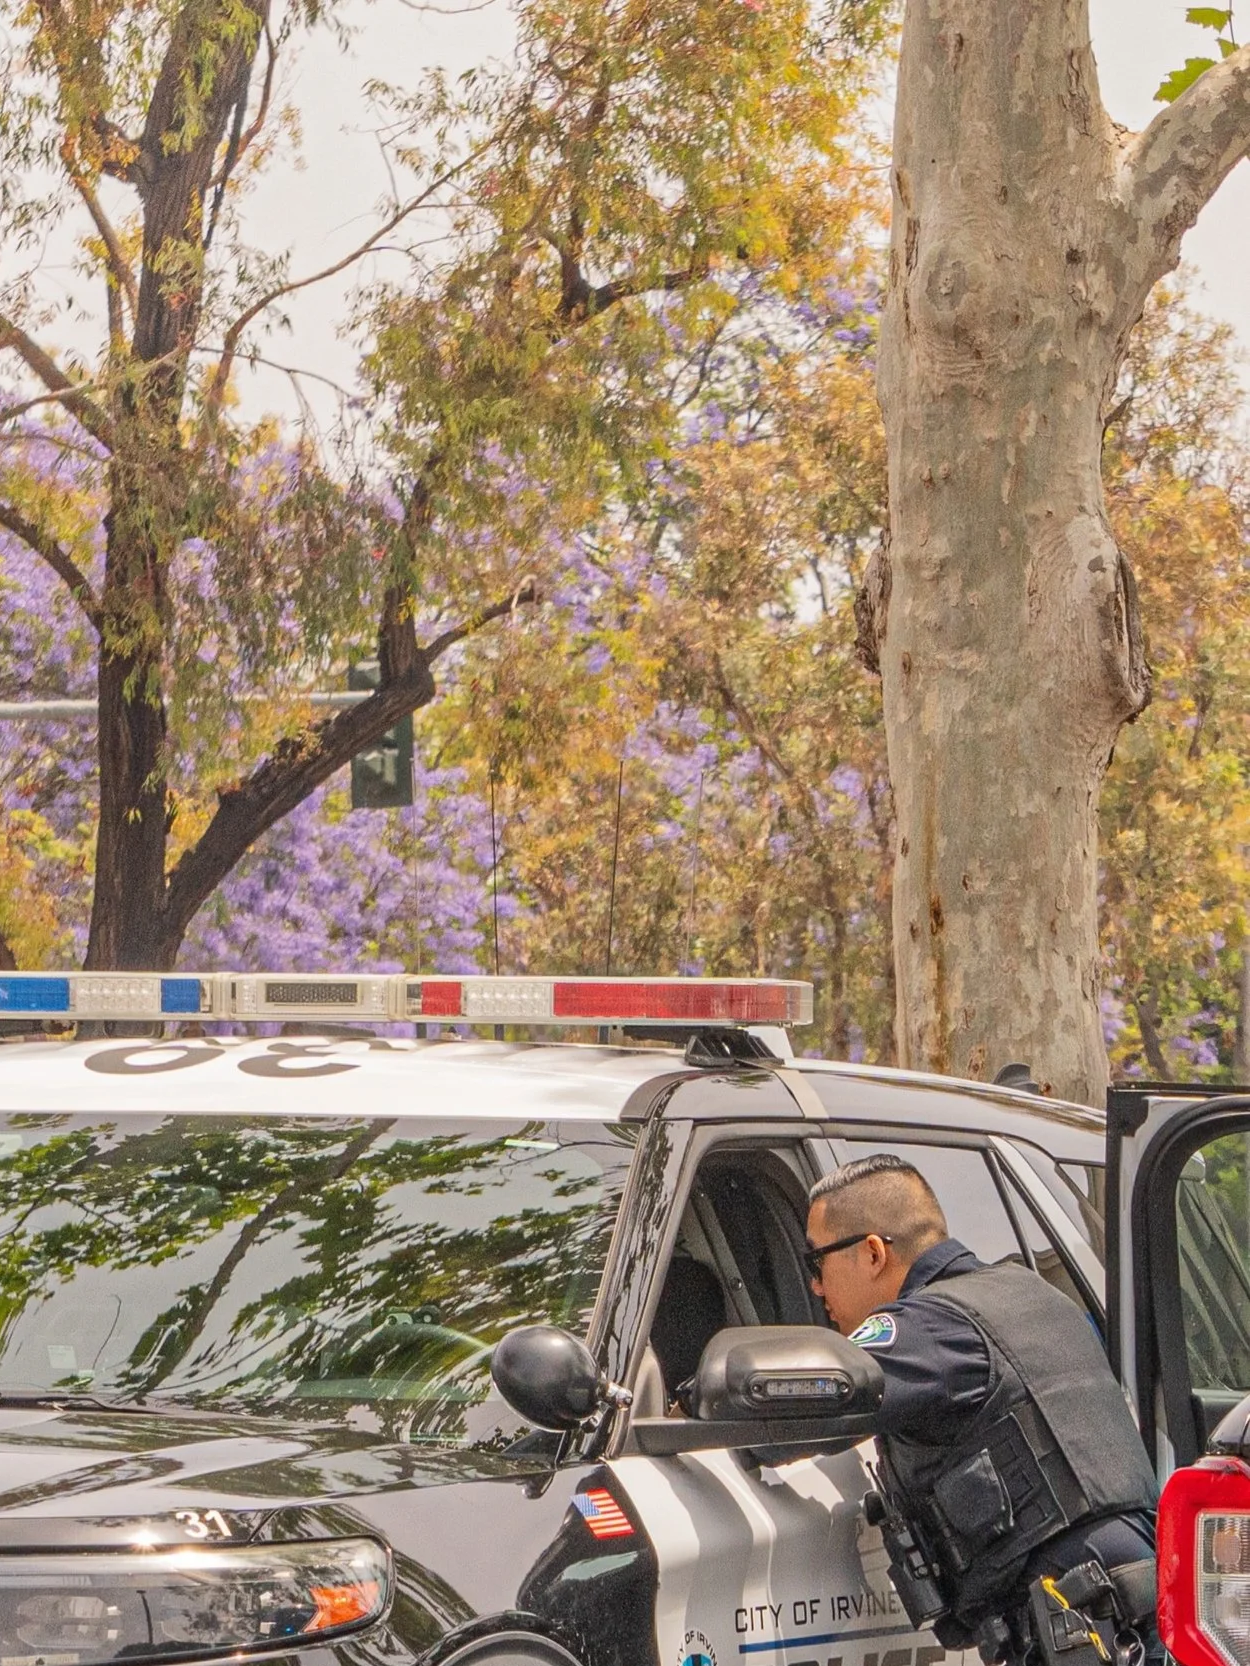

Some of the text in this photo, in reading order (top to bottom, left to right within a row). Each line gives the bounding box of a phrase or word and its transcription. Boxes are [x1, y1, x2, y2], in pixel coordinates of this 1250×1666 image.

[176, 1510, 232, 1538] 31
[735, 1590, 900, 1633] CITY OF IRVINE
